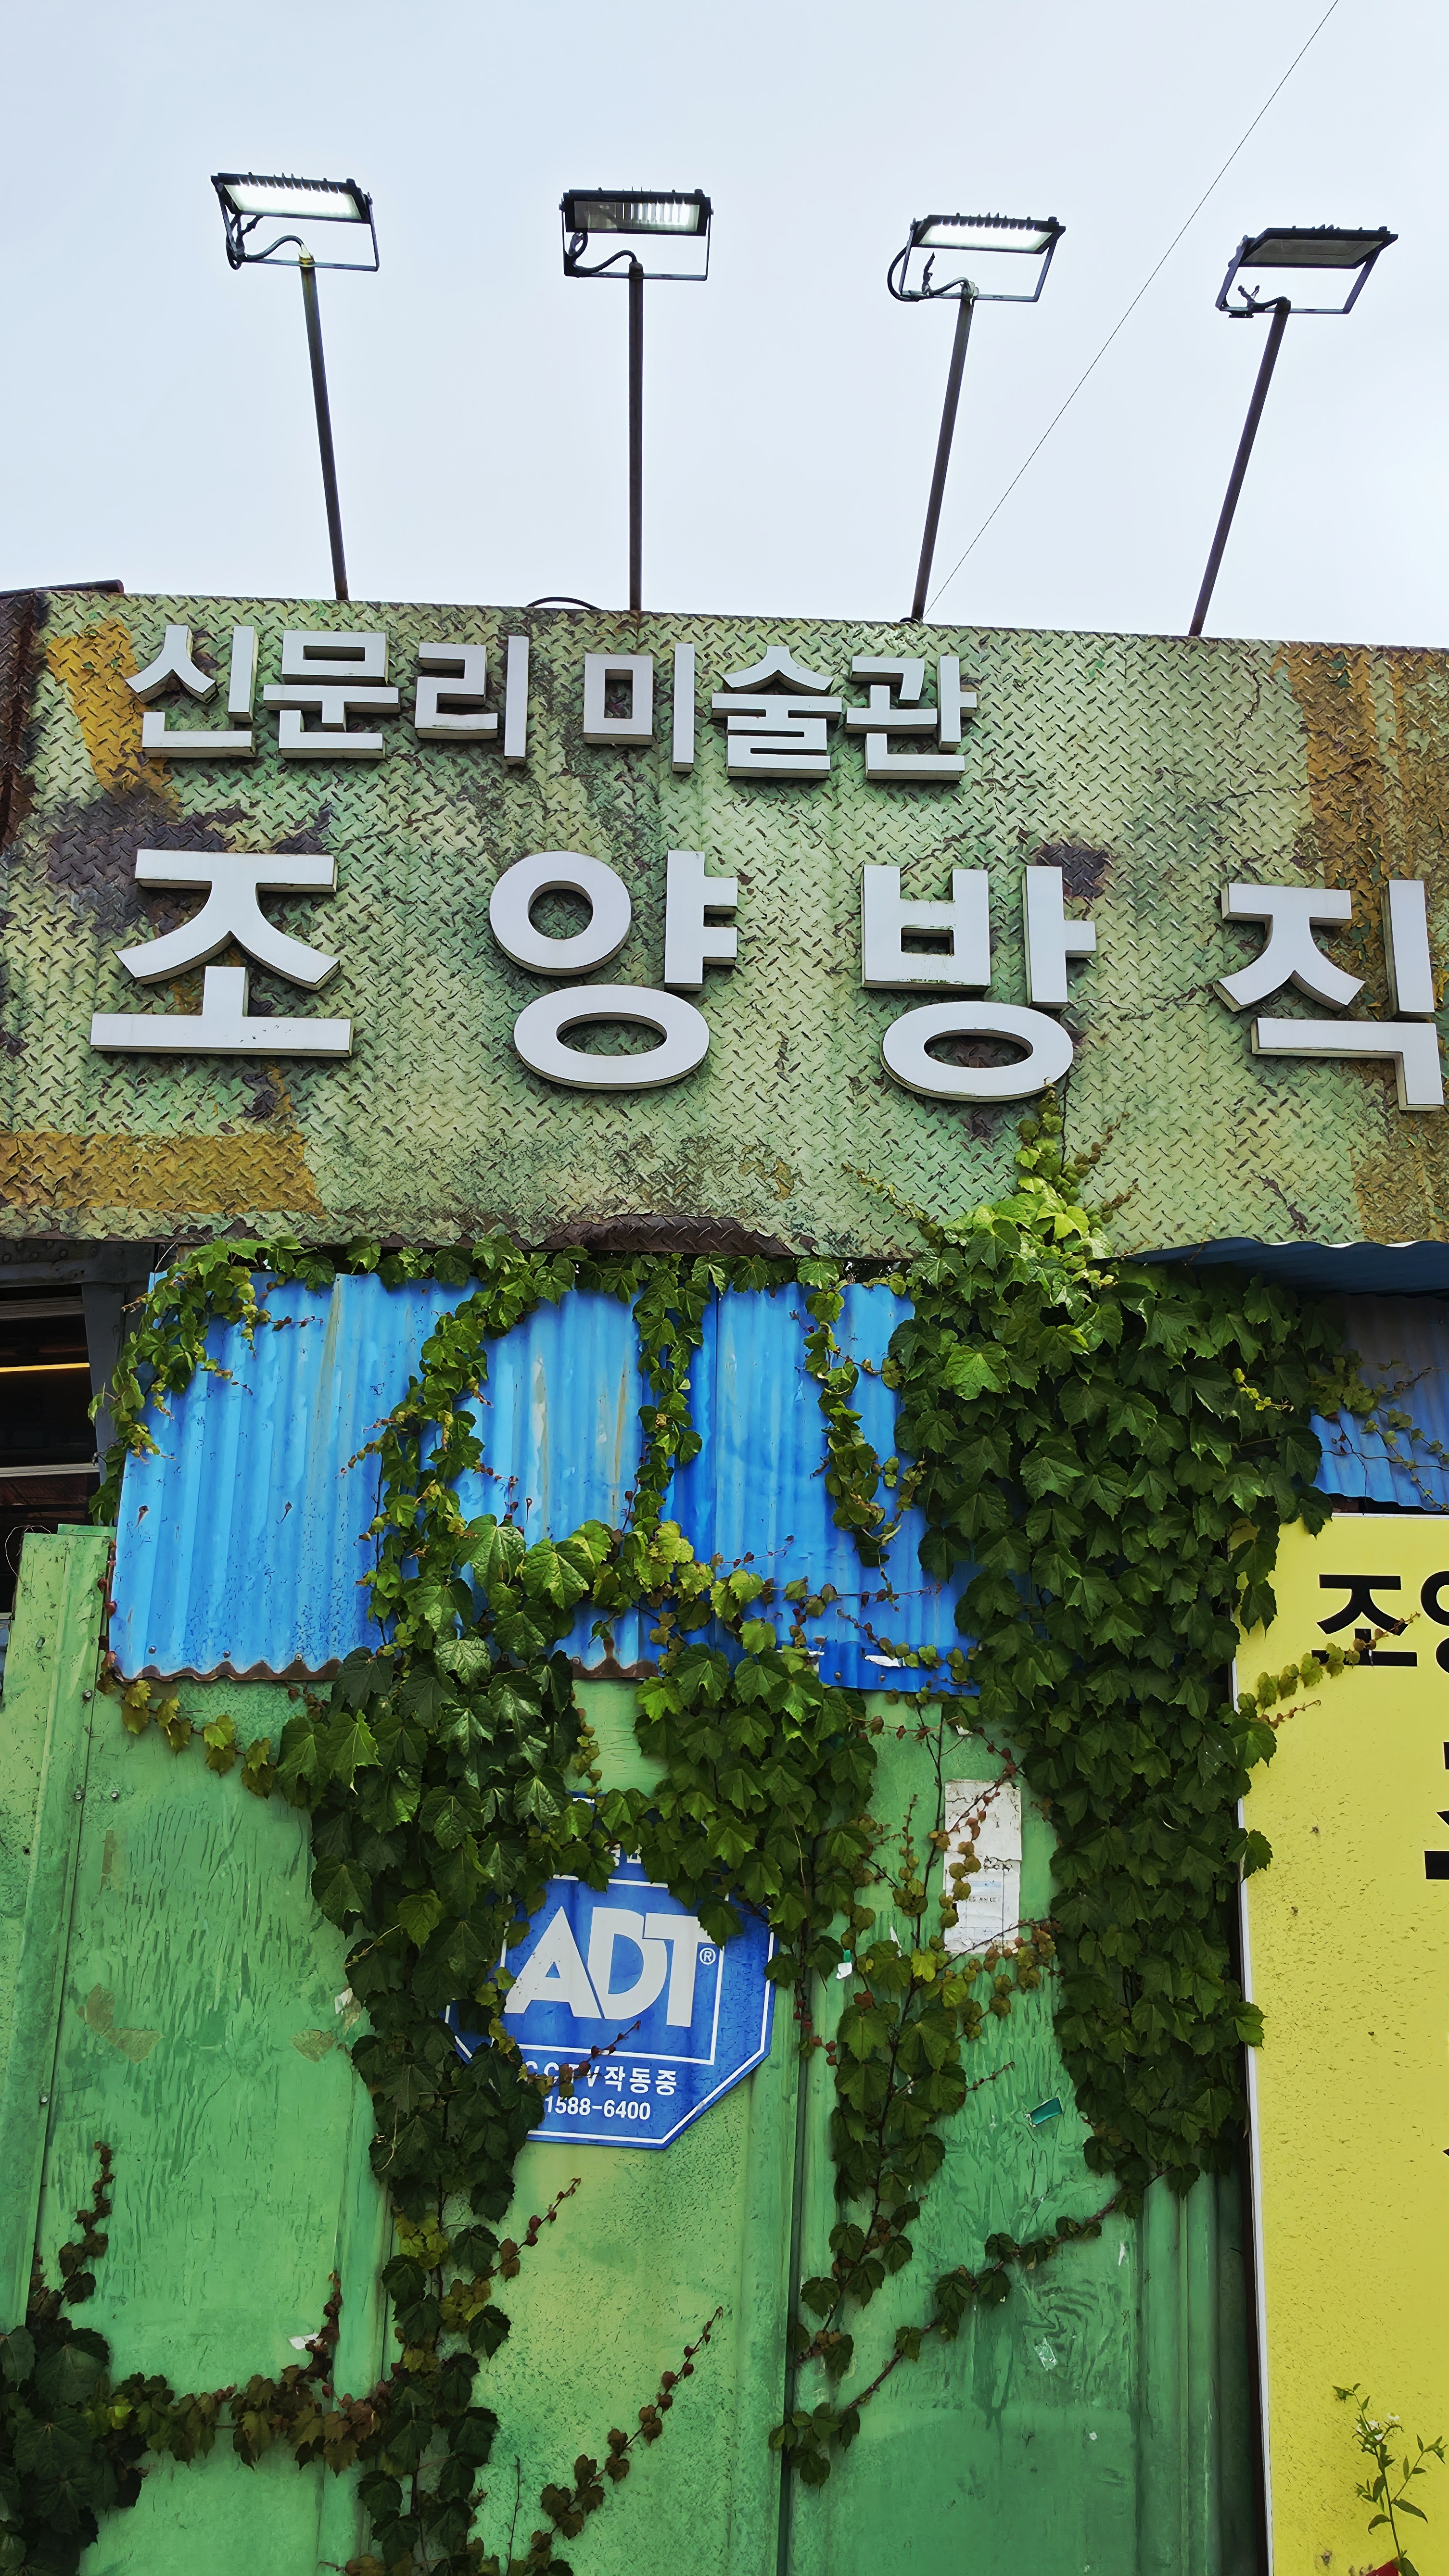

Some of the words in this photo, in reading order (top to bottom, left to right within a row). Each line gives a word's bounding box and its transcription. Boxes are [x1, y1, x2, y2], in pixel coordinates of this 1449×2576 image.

[125, 624, 529, 765] 신문리
[583, 643, 978, 781] 미술관
[90, 848, 1445, 1112] 조양방직
[1311, 1570, 1449, 1675] 조
[545, 2096, 651, 2120] 1588-6400
